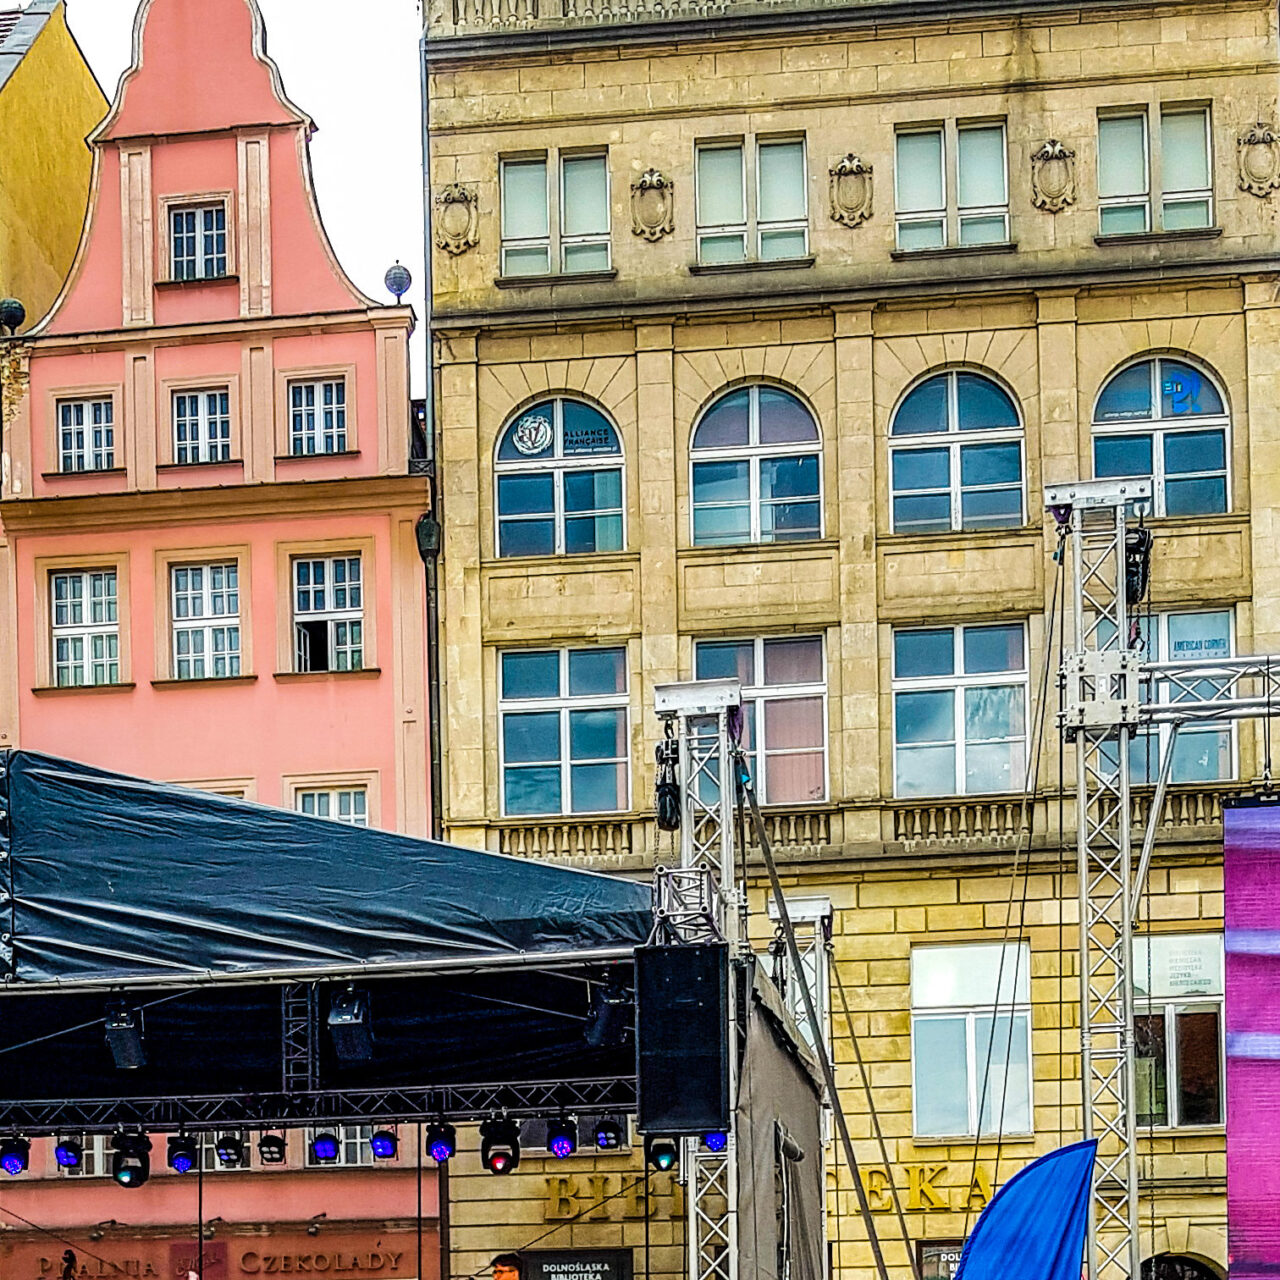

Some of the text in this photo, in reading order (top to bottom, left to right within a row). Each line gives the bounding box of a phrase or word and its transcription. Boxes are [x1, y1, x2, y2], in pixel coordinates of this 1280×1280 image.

[564, 428, 608, 438] ALLIANCE
[37, 1257, 160, 1280] PIALNIA
[543, 1262, 610, 1274] DOLNOŚLĄSKA
